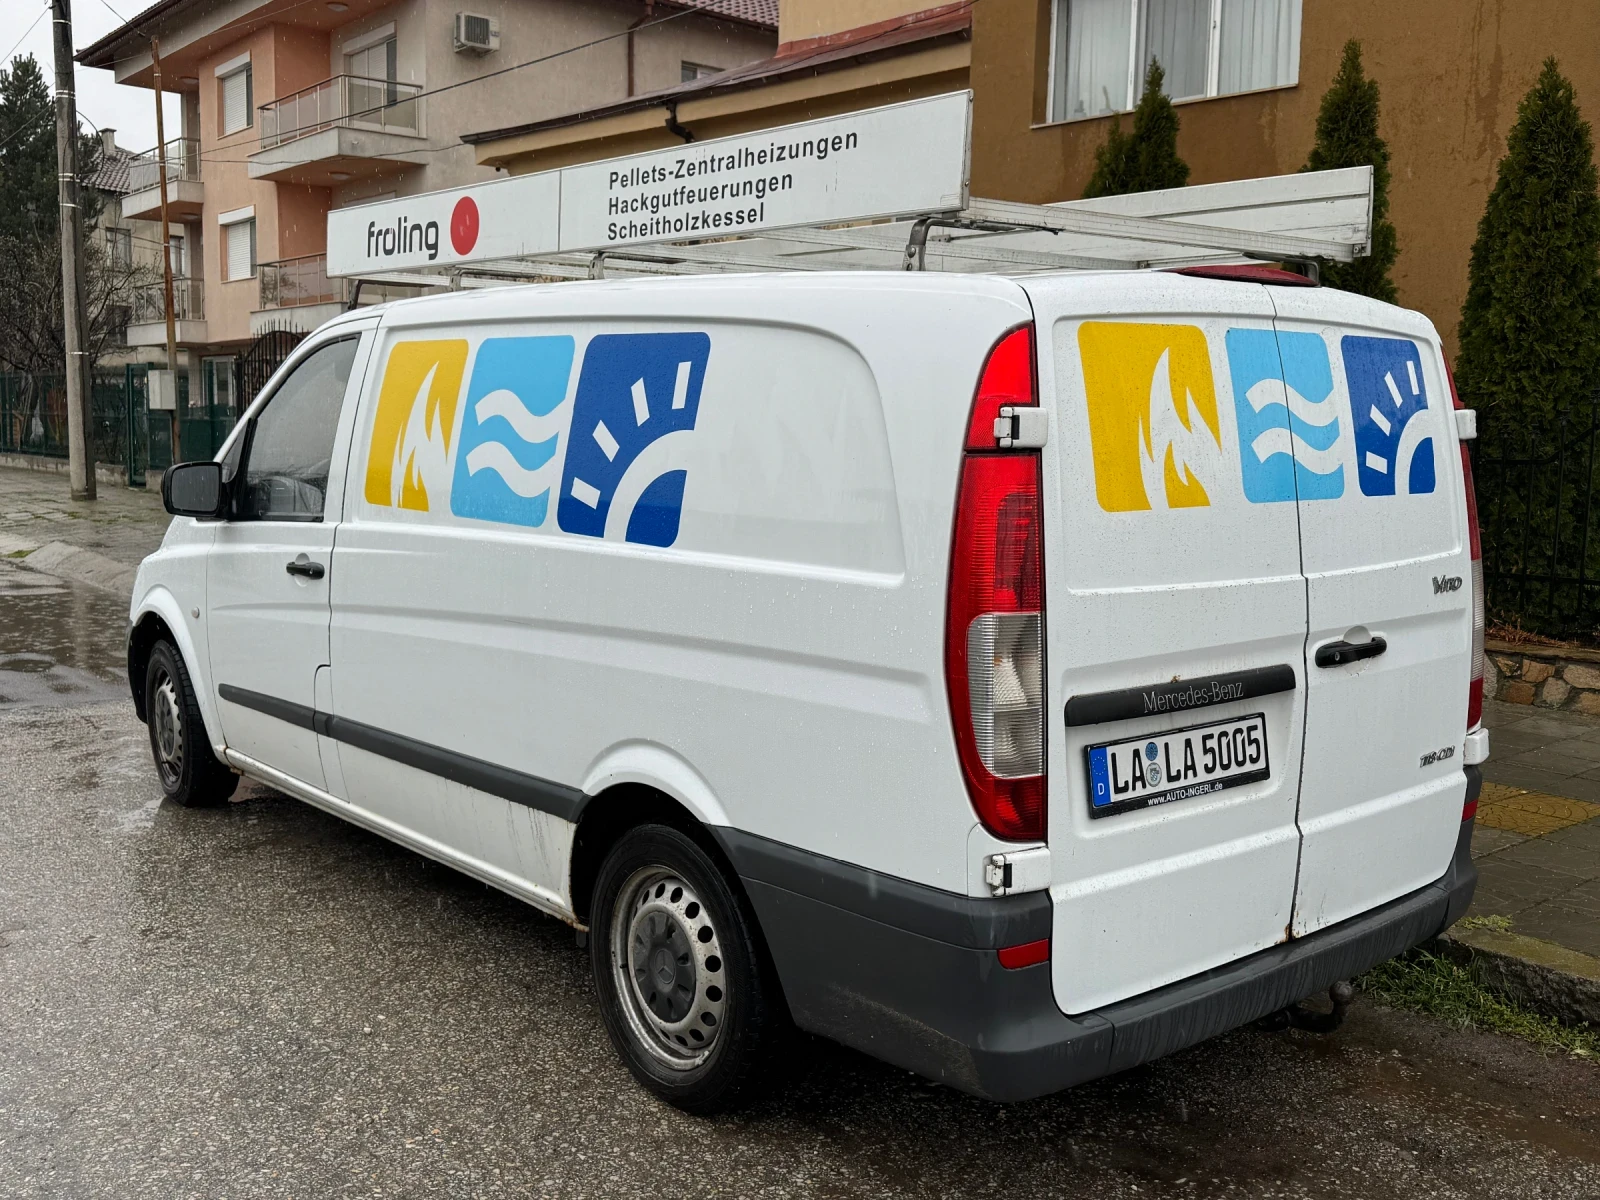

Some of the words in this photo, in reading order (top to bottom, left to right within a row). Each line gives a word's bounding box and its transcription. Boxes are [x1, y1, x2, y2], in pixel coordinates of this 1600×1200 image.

[609, 131, 858, 190] Pellets-Zentralheizungen
[608, 173, 793, 216] Hackgutfeuerungen
[607, 202, 765, 241] Scheitholzkessel
[1142, 681, 1244, 714] Mercedes-Benz
[1111, 748, 1147, 795] LA
[1164, 738, 1198, 783] LA
[1202, 724, 1261, 774] 5005
[1097, 783, 1105, 796] D
[1147, 781, 1223, 806] www.AUTO-INGERL.de
